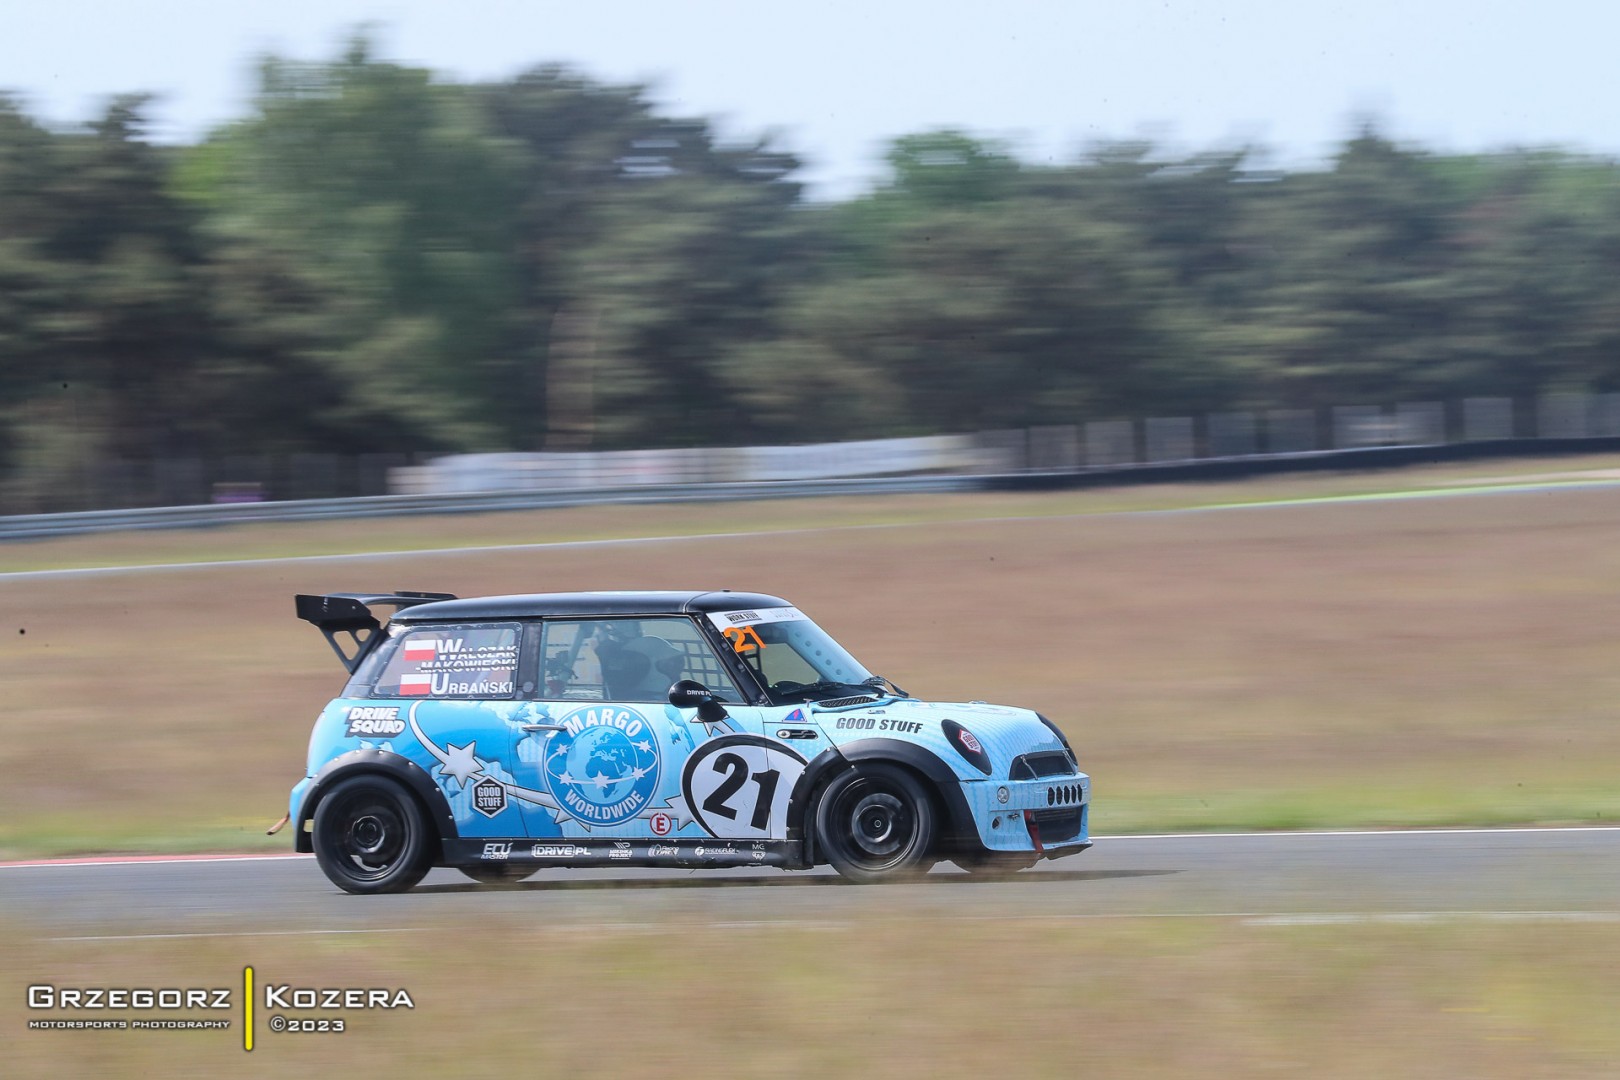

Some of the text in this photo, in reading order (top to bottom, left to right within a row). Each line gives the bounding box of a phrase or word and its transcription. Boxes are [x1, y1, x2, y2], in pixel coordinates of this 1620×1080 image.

[723, 625, 767, 653] 21
[436, 638, 517, 661] WALCZAK
[419, 658, 517, 673] MAKOWIECKI
[431, 673, 513, 695] URBAŃSKI
[348, 707, 400, 720] DRIVE
[349, 720, 406, 734] SQUAD
[562, 708, 643, 738] MARGO
[836, 717, 924, 734] GOOD STUFF
[477, 786, 501, 797] GOOD
[702, 752, 781, 831] 21
[478, 797, 502, 807] STUFF
[564, 788, 645, 820] WORLDWIDE
[655, 817, 666, 832] E
[483, 842, 514, 855] ECU
